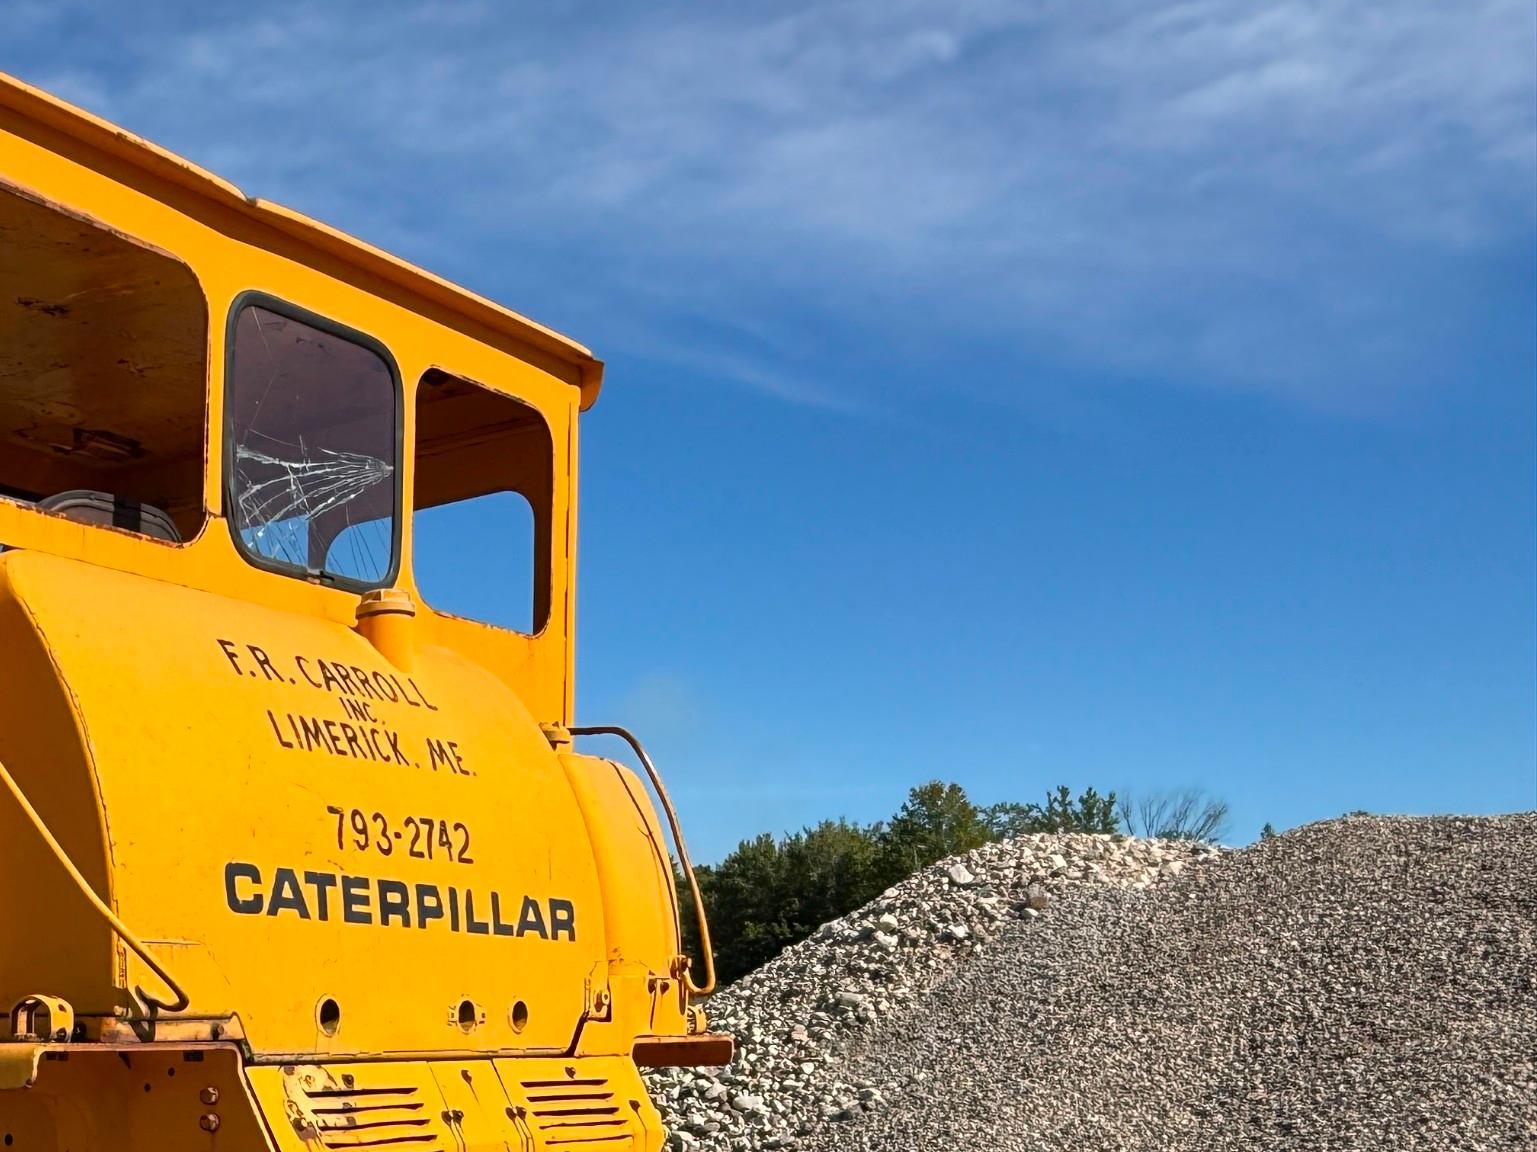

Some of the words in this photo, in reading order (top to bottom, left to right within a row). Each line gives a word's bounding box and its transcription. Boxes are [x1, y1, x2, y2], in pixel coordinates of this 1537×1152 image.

[295, 654, 439, 711] CARROLL
[327, 805, 474, 864] 793-2742
[224, 862, 577, 942] CATERPILLAR
